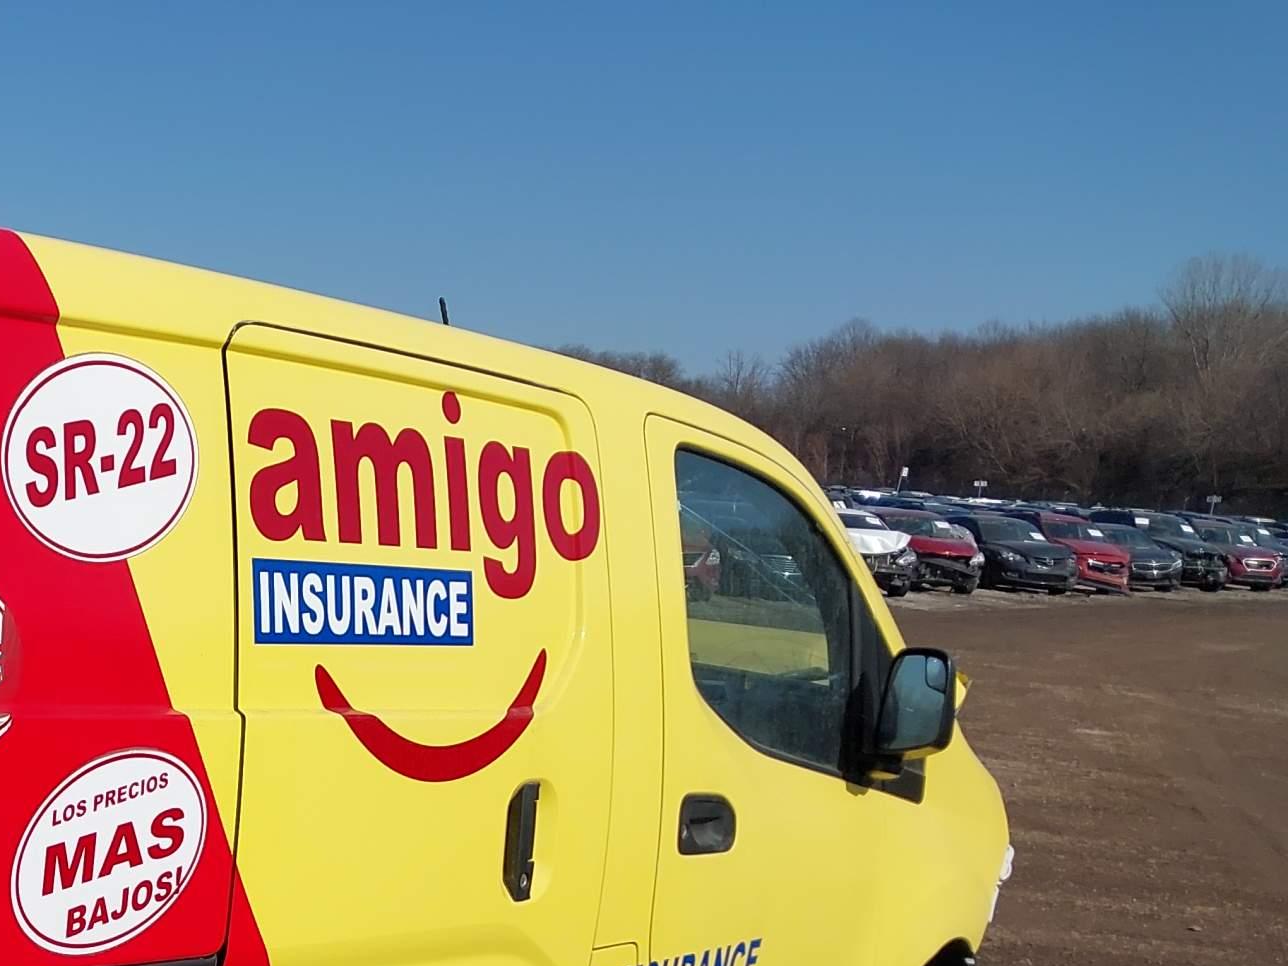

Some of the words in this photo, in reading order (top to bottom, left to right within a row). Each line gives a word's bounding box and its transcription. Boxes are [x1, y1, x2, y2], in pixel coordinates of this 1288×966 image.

[25, 402, 177, 508] SR-22
[248, 391, 601, 600] amigo
[258, 571, 470, 638] INSURANCE
[51, 799, 87, 827] LOS
[93, 772, 169, 812] PRECIOS
[41, 807, 186, 897] MAS
[66, 866, 183, 939] BAJOS!
